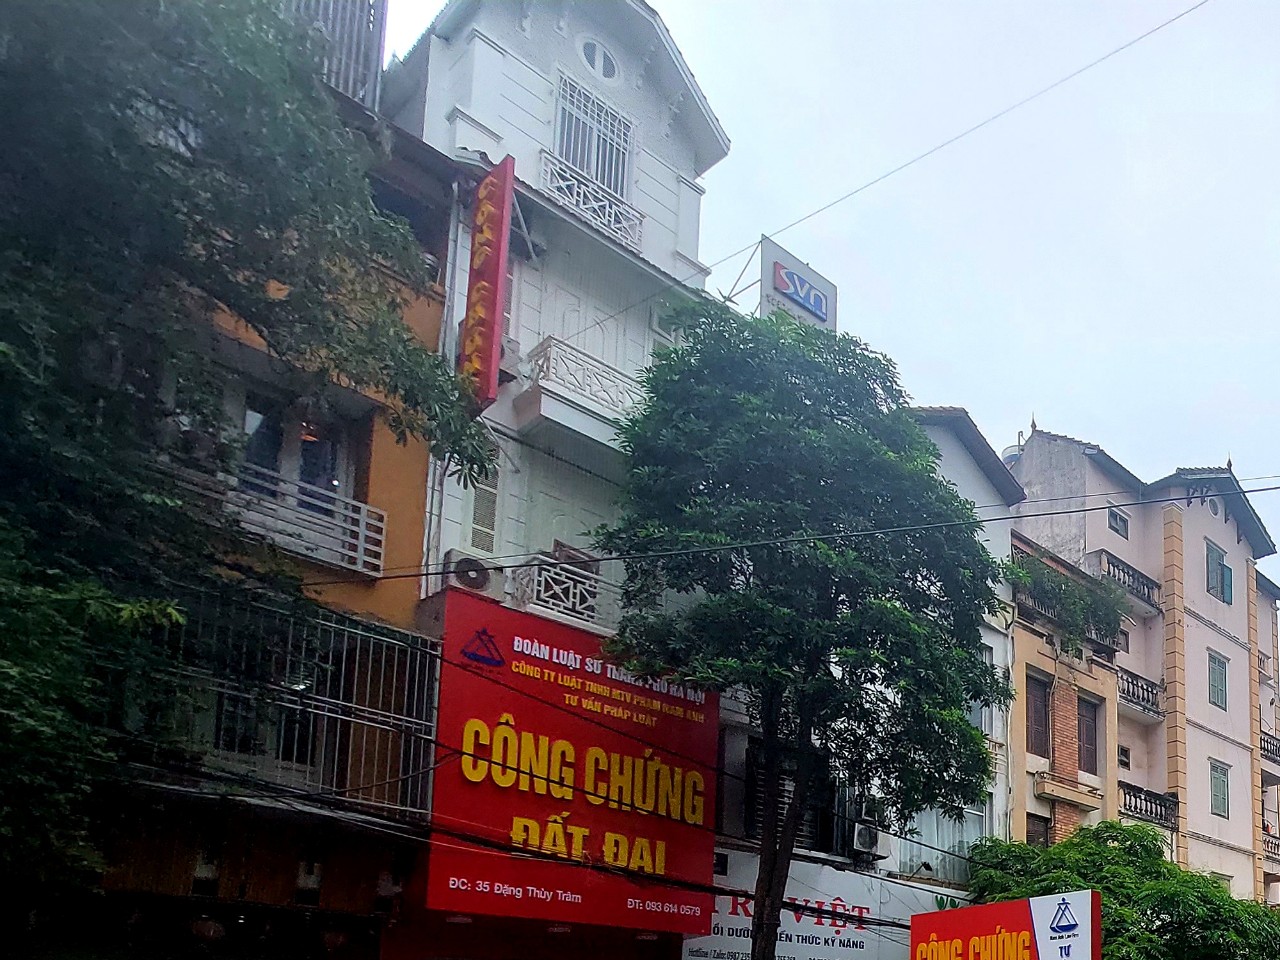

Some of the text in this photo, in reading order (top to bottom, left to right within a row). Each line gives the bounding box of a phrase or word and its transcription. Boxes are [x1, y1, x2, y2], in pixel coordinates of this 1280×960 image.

[513, 636, 549, 660] ĐOÀN
[552, 648, 582, 671] LUẬT
[585, 657, 603, 674] SƯ
[511, 660, 541, 680] CÔNG
[543, 668, 556, 683] TY
[557, 673, 582, 693] LUẬT
[585, 680, 610, 697] TNHH
[611, 687, 632, 703] MTV
[563, 693, 658, 728] TƯ VẤN PHÁP LUẬT
[461, 712, 705, 826] CÔNG CHỨNG
[510, 811, 666, 875] ĐẤT ĐAI
[448, 877, 472, 891] ĐC:
[475, 881, 490, 893] 35
[494, 882, 523, 899] Đặng
[556, 889, 582, 903] Trâm
[627, 898, 644, 910] ĐT:
[645, 901, 662, 913] 093
[663, 902, 678, 914] 614
[679, 904, 701, 916] 0579
[786, 896, 871, 936] VIỆT
[775, 929, 793, 944] IẾN
[795, 931, 821, 946] THỨC
[823, 933, 839, 948] KỸ
[838, 935, 865, 950] NĂNG
[1058, 944, 1072, 959] TƯ
